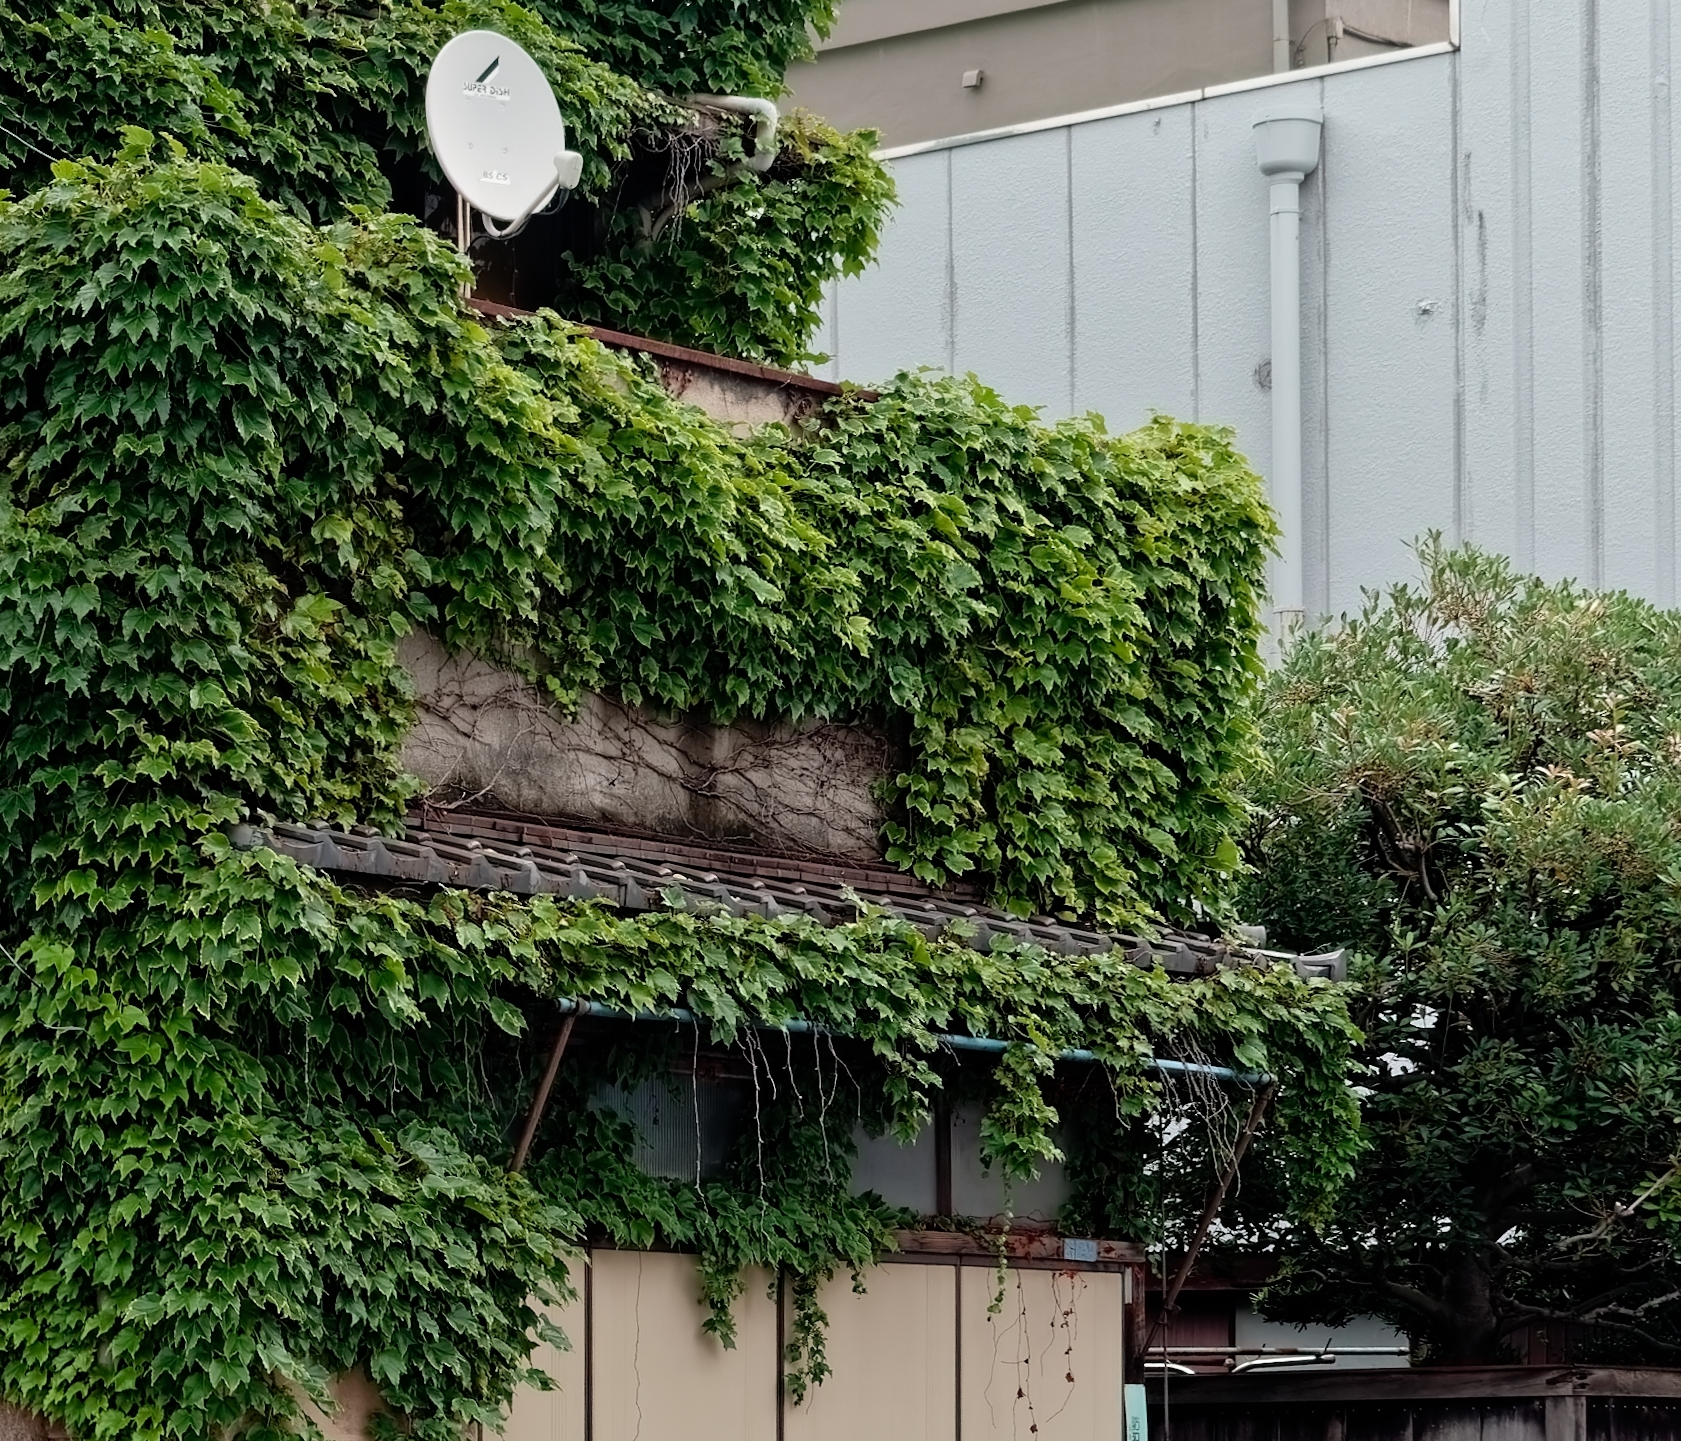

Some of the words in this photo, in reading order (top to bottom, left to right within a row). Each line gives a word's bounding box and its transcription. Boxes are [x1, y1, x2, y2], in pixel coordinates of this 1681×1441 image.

[463, 82, 487, 94] SUPER
[483, 171, 494, 179] BS
[496, 172, 508, 181] CS
